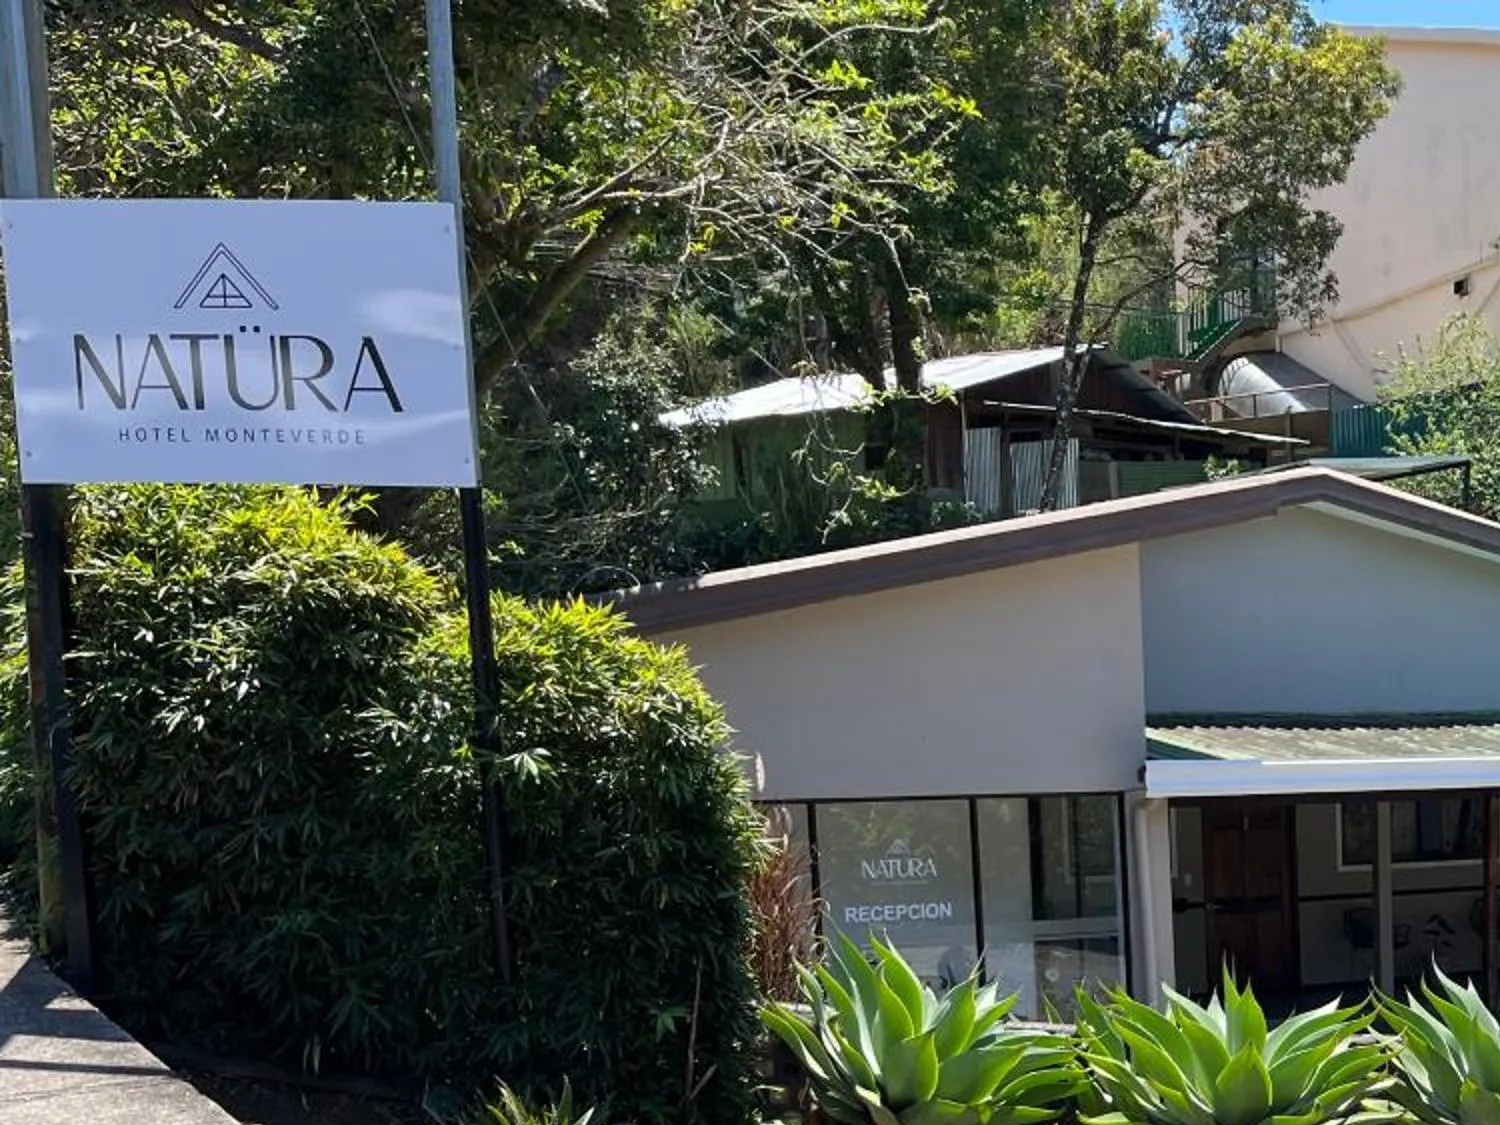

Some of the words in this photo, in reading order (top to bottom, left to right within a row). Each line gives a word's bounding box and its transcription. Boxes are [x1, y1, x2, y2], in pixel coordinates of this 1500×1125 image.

[73, 325, 403, 413] NATÜRA
[118, 427, 192, 443] HOTEL
[205, 427, 367, 445] MONTEVERDE
[844, 901, 952, 923] RECEPCION
